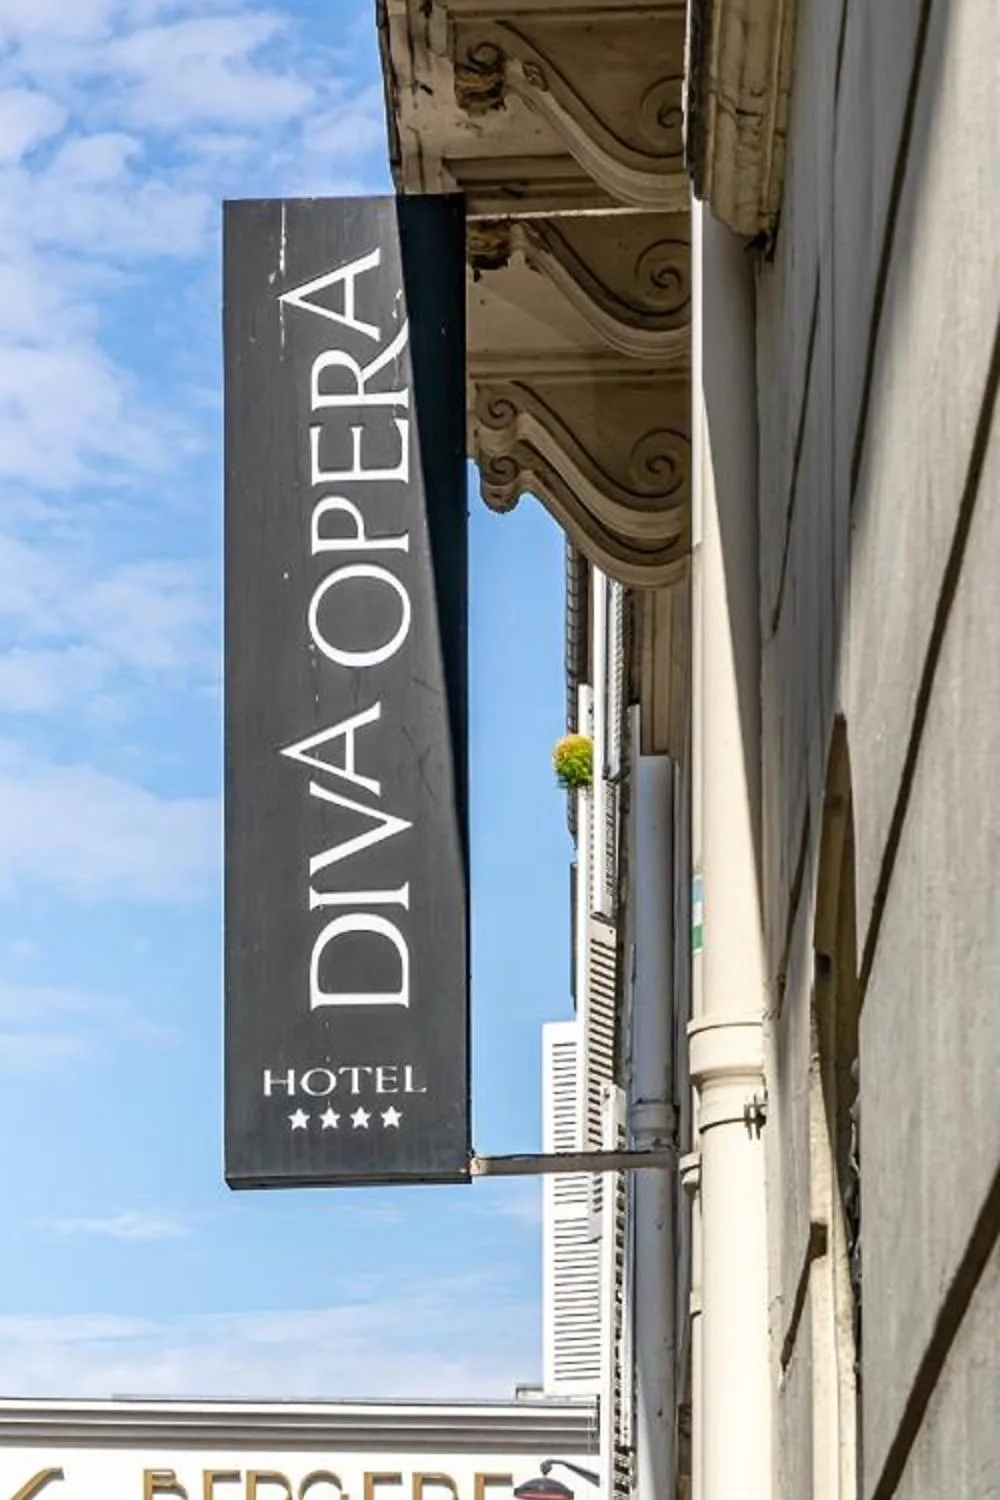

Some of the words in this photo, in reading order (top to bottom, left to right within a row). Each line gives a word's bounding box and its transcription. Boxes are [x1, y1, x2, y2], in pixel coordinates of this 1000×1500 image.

[280, 247, 411, 669] OPERA
[280, 702, 413, 1010] DIVA
[263, 1066, 427, 1097] HOTEL
